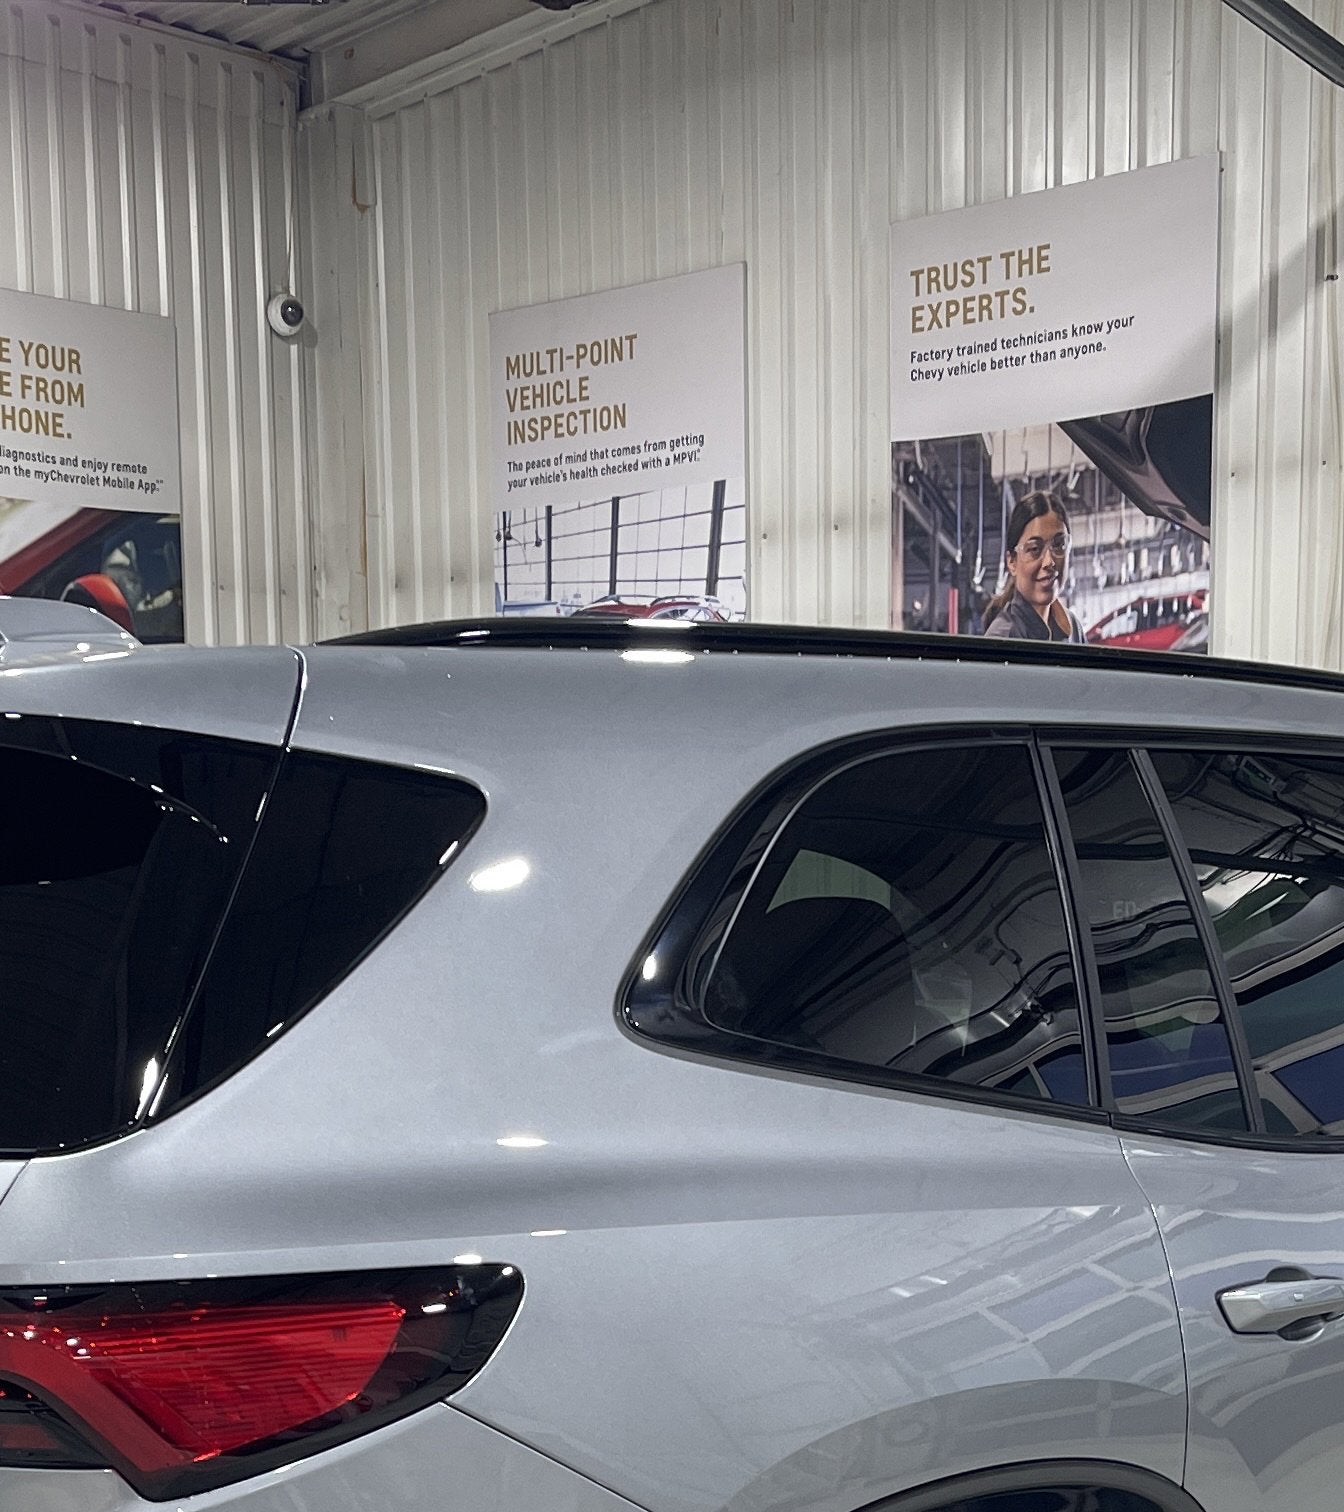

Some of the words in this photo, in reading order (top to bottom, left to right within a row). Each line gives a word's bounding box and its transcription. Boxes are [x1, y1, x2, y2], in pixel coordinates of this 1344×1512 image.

[910, 255, 992, 297] TRUST
[1000, 243, 1051, 281] THE
[911, 286, 1035, 334] EXPERTS.
[18, 340, 82, 375] YOUR
[505, 333, 638, 380] MULTI-POINT
[910, 341, 953, 364] Factory
[956, 338, 998, 358] trained
[1001, 327, 1068, 350] technicians
[1071, 320, 1104, 338] know
[1106, 315, 1135, 335] your
[910, 365, 944, 382] Chevy
[947, 359, 987, 377] vehicle
[990, 353, 1026, 371] better
[1029, 347, 1056, 364] than
[1059, 340, 1107, 360] anyone.
[21, 374, 85, 408] FROM
[506, 376, 590, 413] VEHICLE
[507, 403, 627, 446] INSPECTION
[59, 455, 78, 468] and
[81, 458, 109, 473] enjoy
[111, 462, 148, 475] remote
[507, 461, 523, 473] The
[525, 457, 552, 476] peace
[553, 452, 564, 467] of
[564, 449, 588, 465] mind
[589, 447, 609, 461] that
[611, 444, 642, 458] comes
[643, 440, 667, 453] from
[669, 433, 705, 452] getting
[507, 477, 527, 492] your
[529, 470, 568, 486] vehicle's
[569, 465, 598, 481] health
[600, 457, 639, 476] checked
[641, 454, 662, 471] with
[664, 457, 670, 467] a
[13, 465, 31, 478] the
[34, 469, 100, 487] myChevrolet
[102, 475, 135, 490] Mobile
